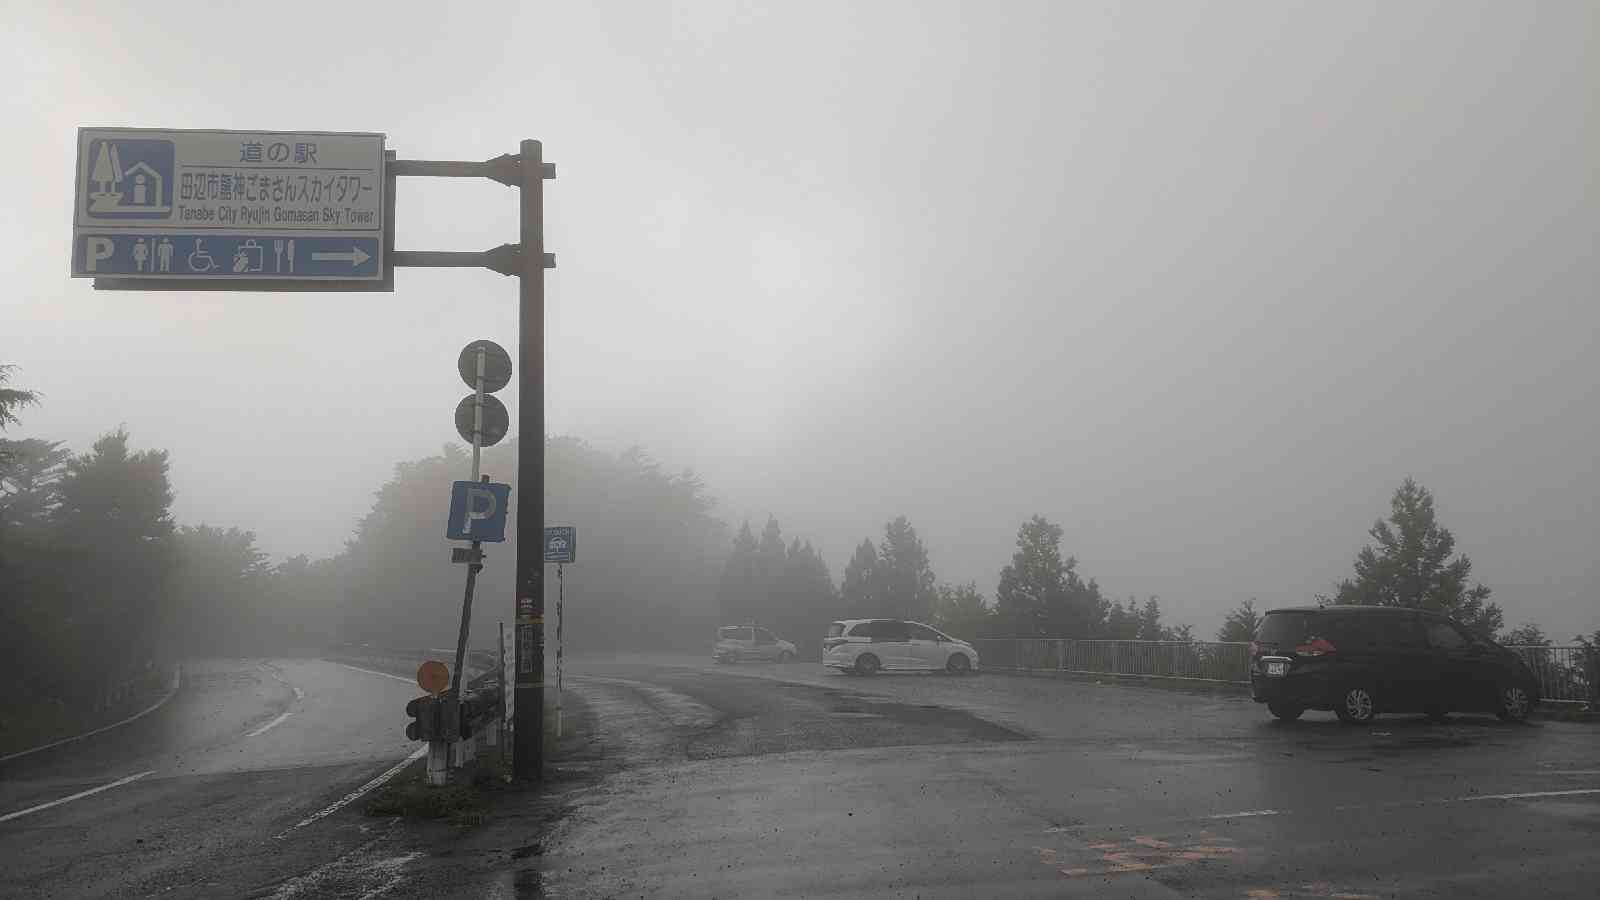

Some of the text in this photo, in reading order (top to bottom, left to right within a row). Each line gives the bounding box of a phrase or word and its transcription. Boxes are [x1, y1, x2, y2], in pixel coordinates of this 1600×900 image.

[239, 141, 318, 164] 道の駅
[180, 172, 373, 204] 田辺市龍神ごまさんスカイタワー
[178, 205, 374, 225] Tanabe City Ryujin Gomasan Sky Tower
[86, 238, 114, 271] P
[462, 488, 497, 534] P
